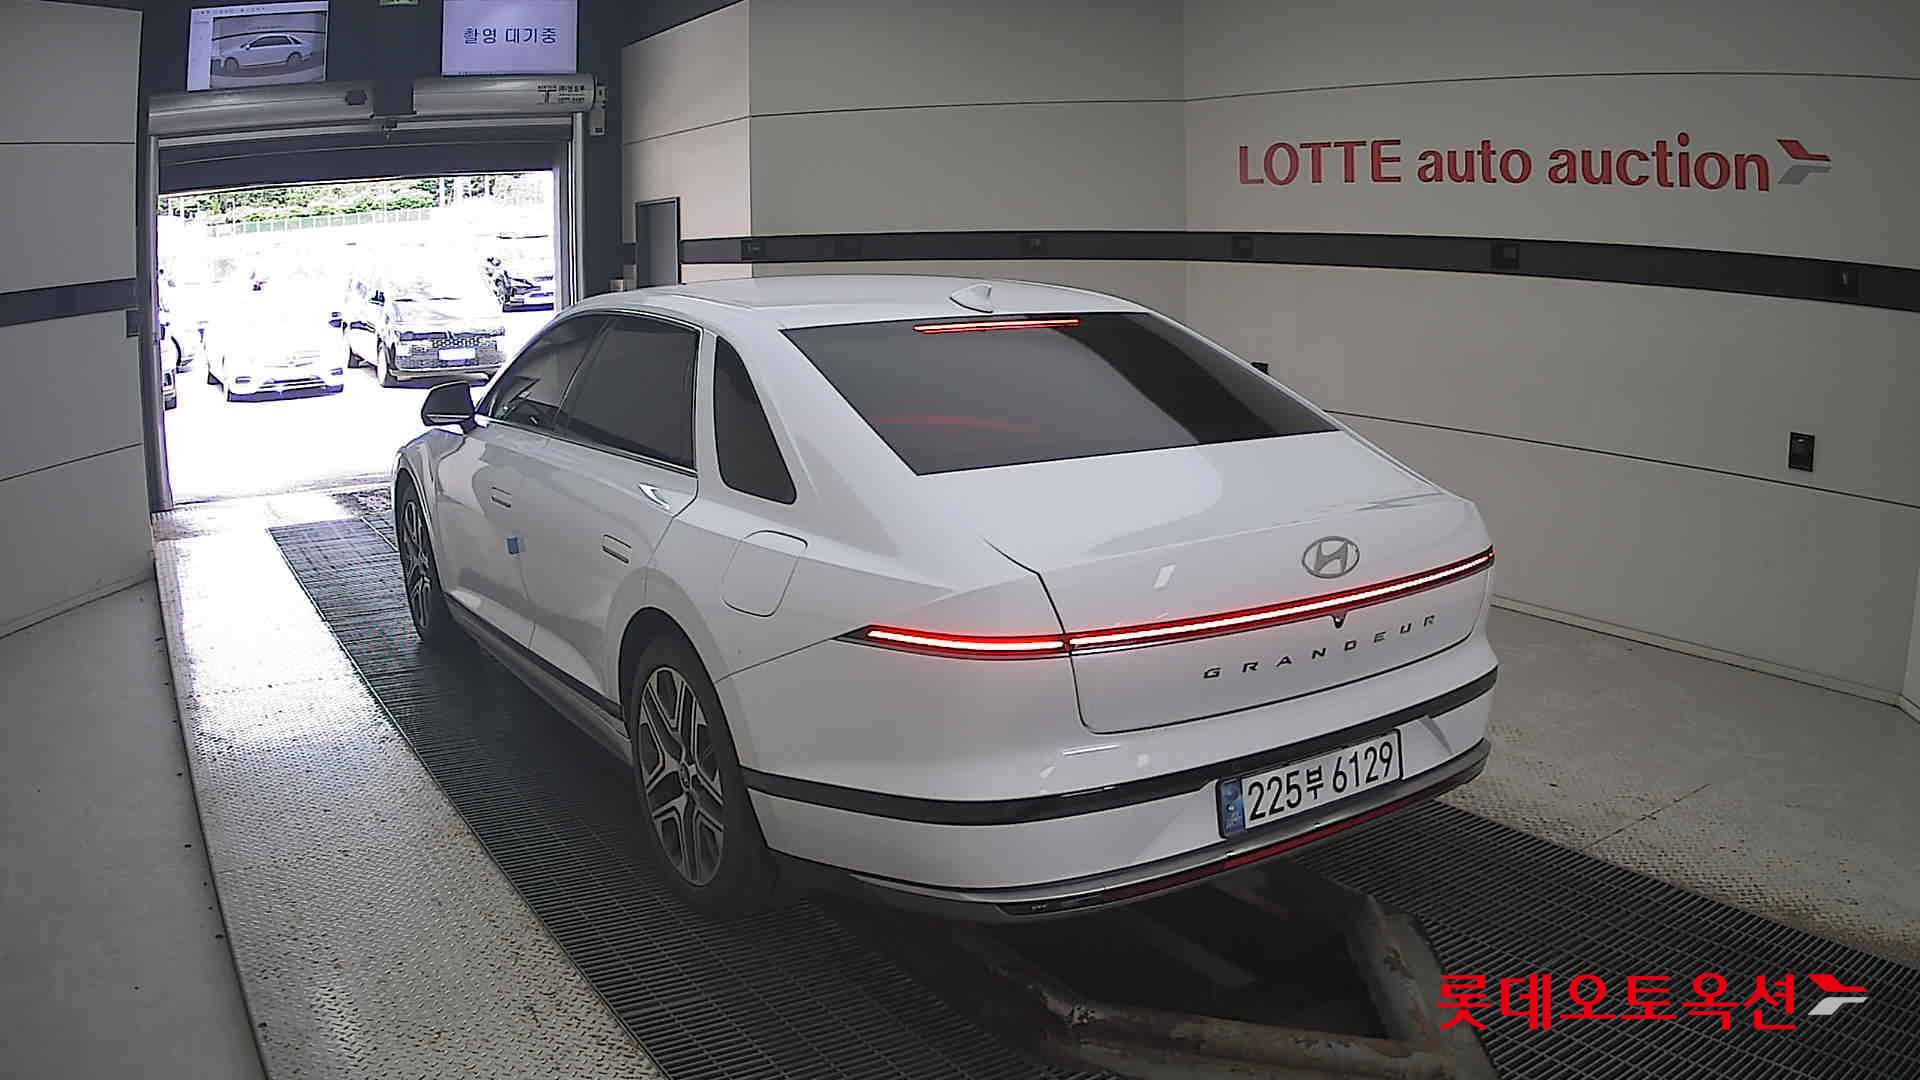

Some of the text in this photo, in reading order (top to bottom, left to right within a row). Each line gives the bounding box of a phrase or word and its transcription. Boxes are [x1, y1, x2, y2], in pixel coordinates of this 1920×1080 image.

[505, 27, 557, 44] 대기중
[1239, 131, 1770, 191] LOTTE auto auction
[1203, 614, 1436, 679] GRANDEUR
[1332, 741, 1393, 793] 6129
